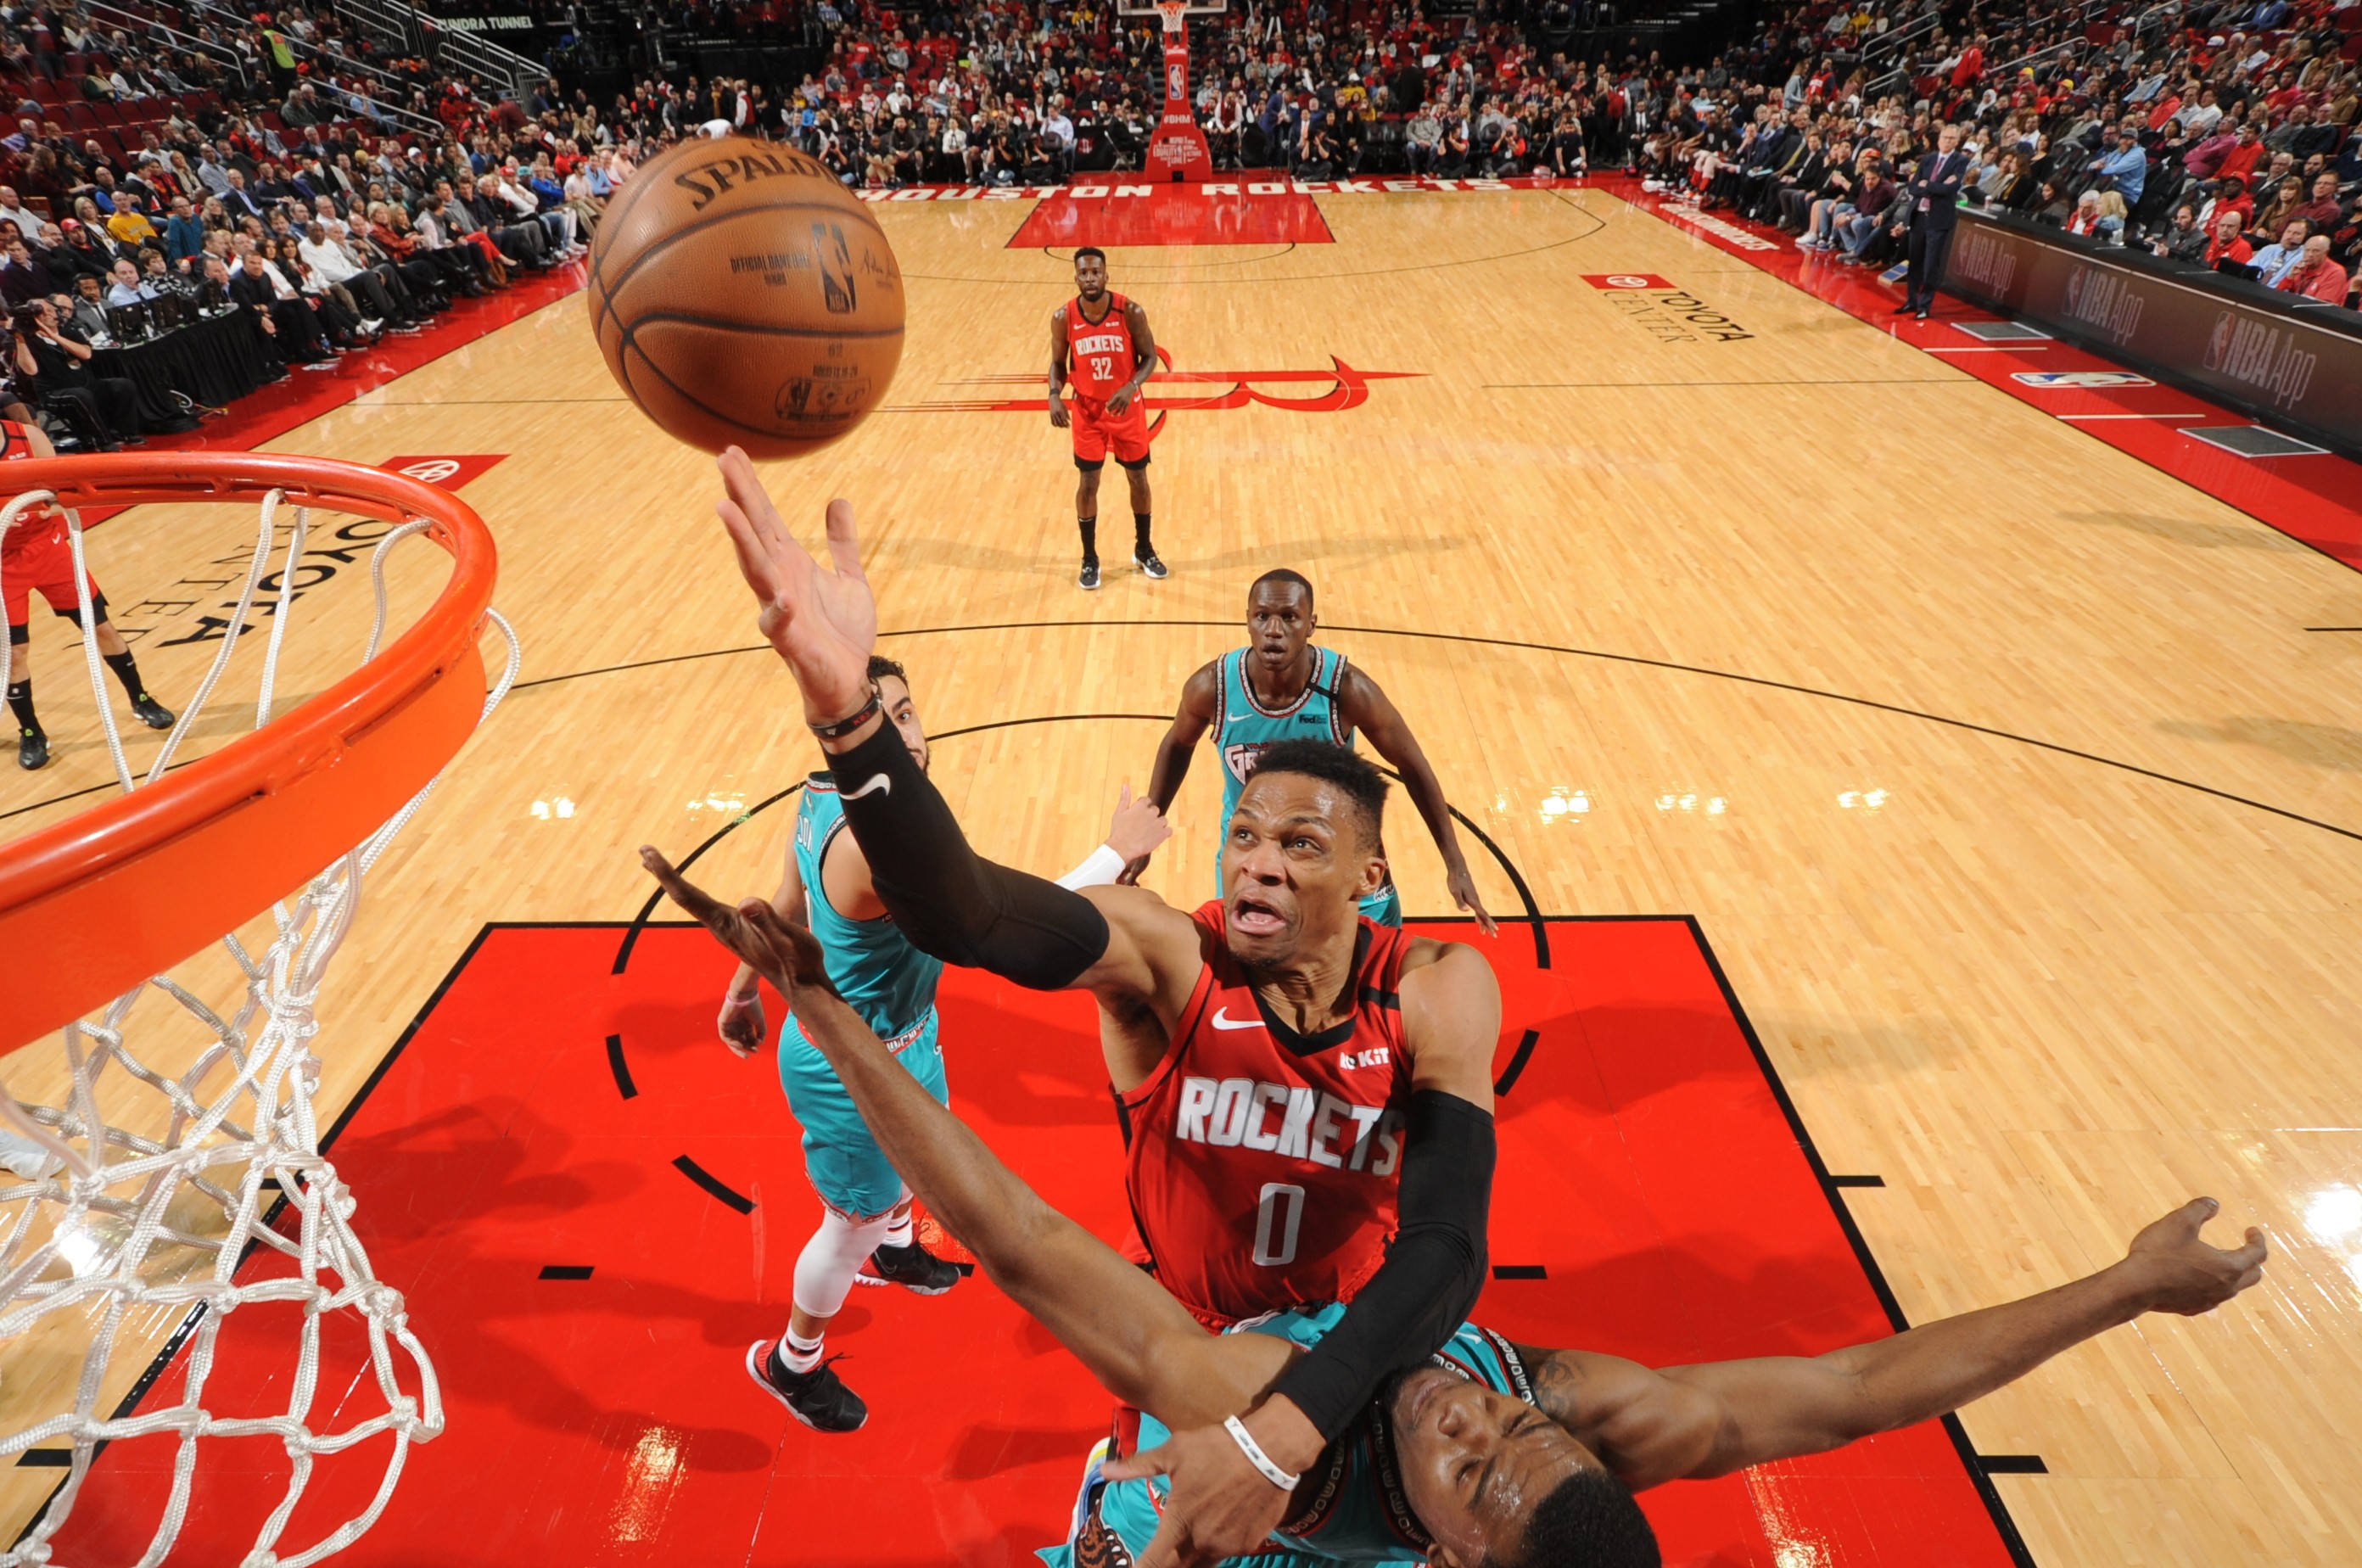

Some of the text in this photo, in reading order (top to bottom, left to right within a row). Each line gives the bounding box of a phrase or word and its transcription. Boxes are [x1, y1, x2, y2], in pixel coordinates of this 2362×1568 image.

[488, 16, 534, 29] TUNNEL
[1163, 115, 1190, 125] #BHM
[854, 178, 1512, 201] HOUSTON ROCKETS
[1964, 232, 2017, 299] NBA App
[1604, 291, 1698, 343] CENTER
[1650, 291, 1756, 342] TOYOTA
[2075, 269, 2144, 346] NBA App
[1075, 334, 1124, 356] ROCKETS
[1091, 356, 1113, 380] 32
[2221, 317, 2317, 411] NBA App
[63, 521, 327, 650] ENTER
[154, 518, 395, 649] OYOTA
[1176, 1076, 1406, 1177] ROCKETS
[1252, 1182, 1306, 1267] 0
